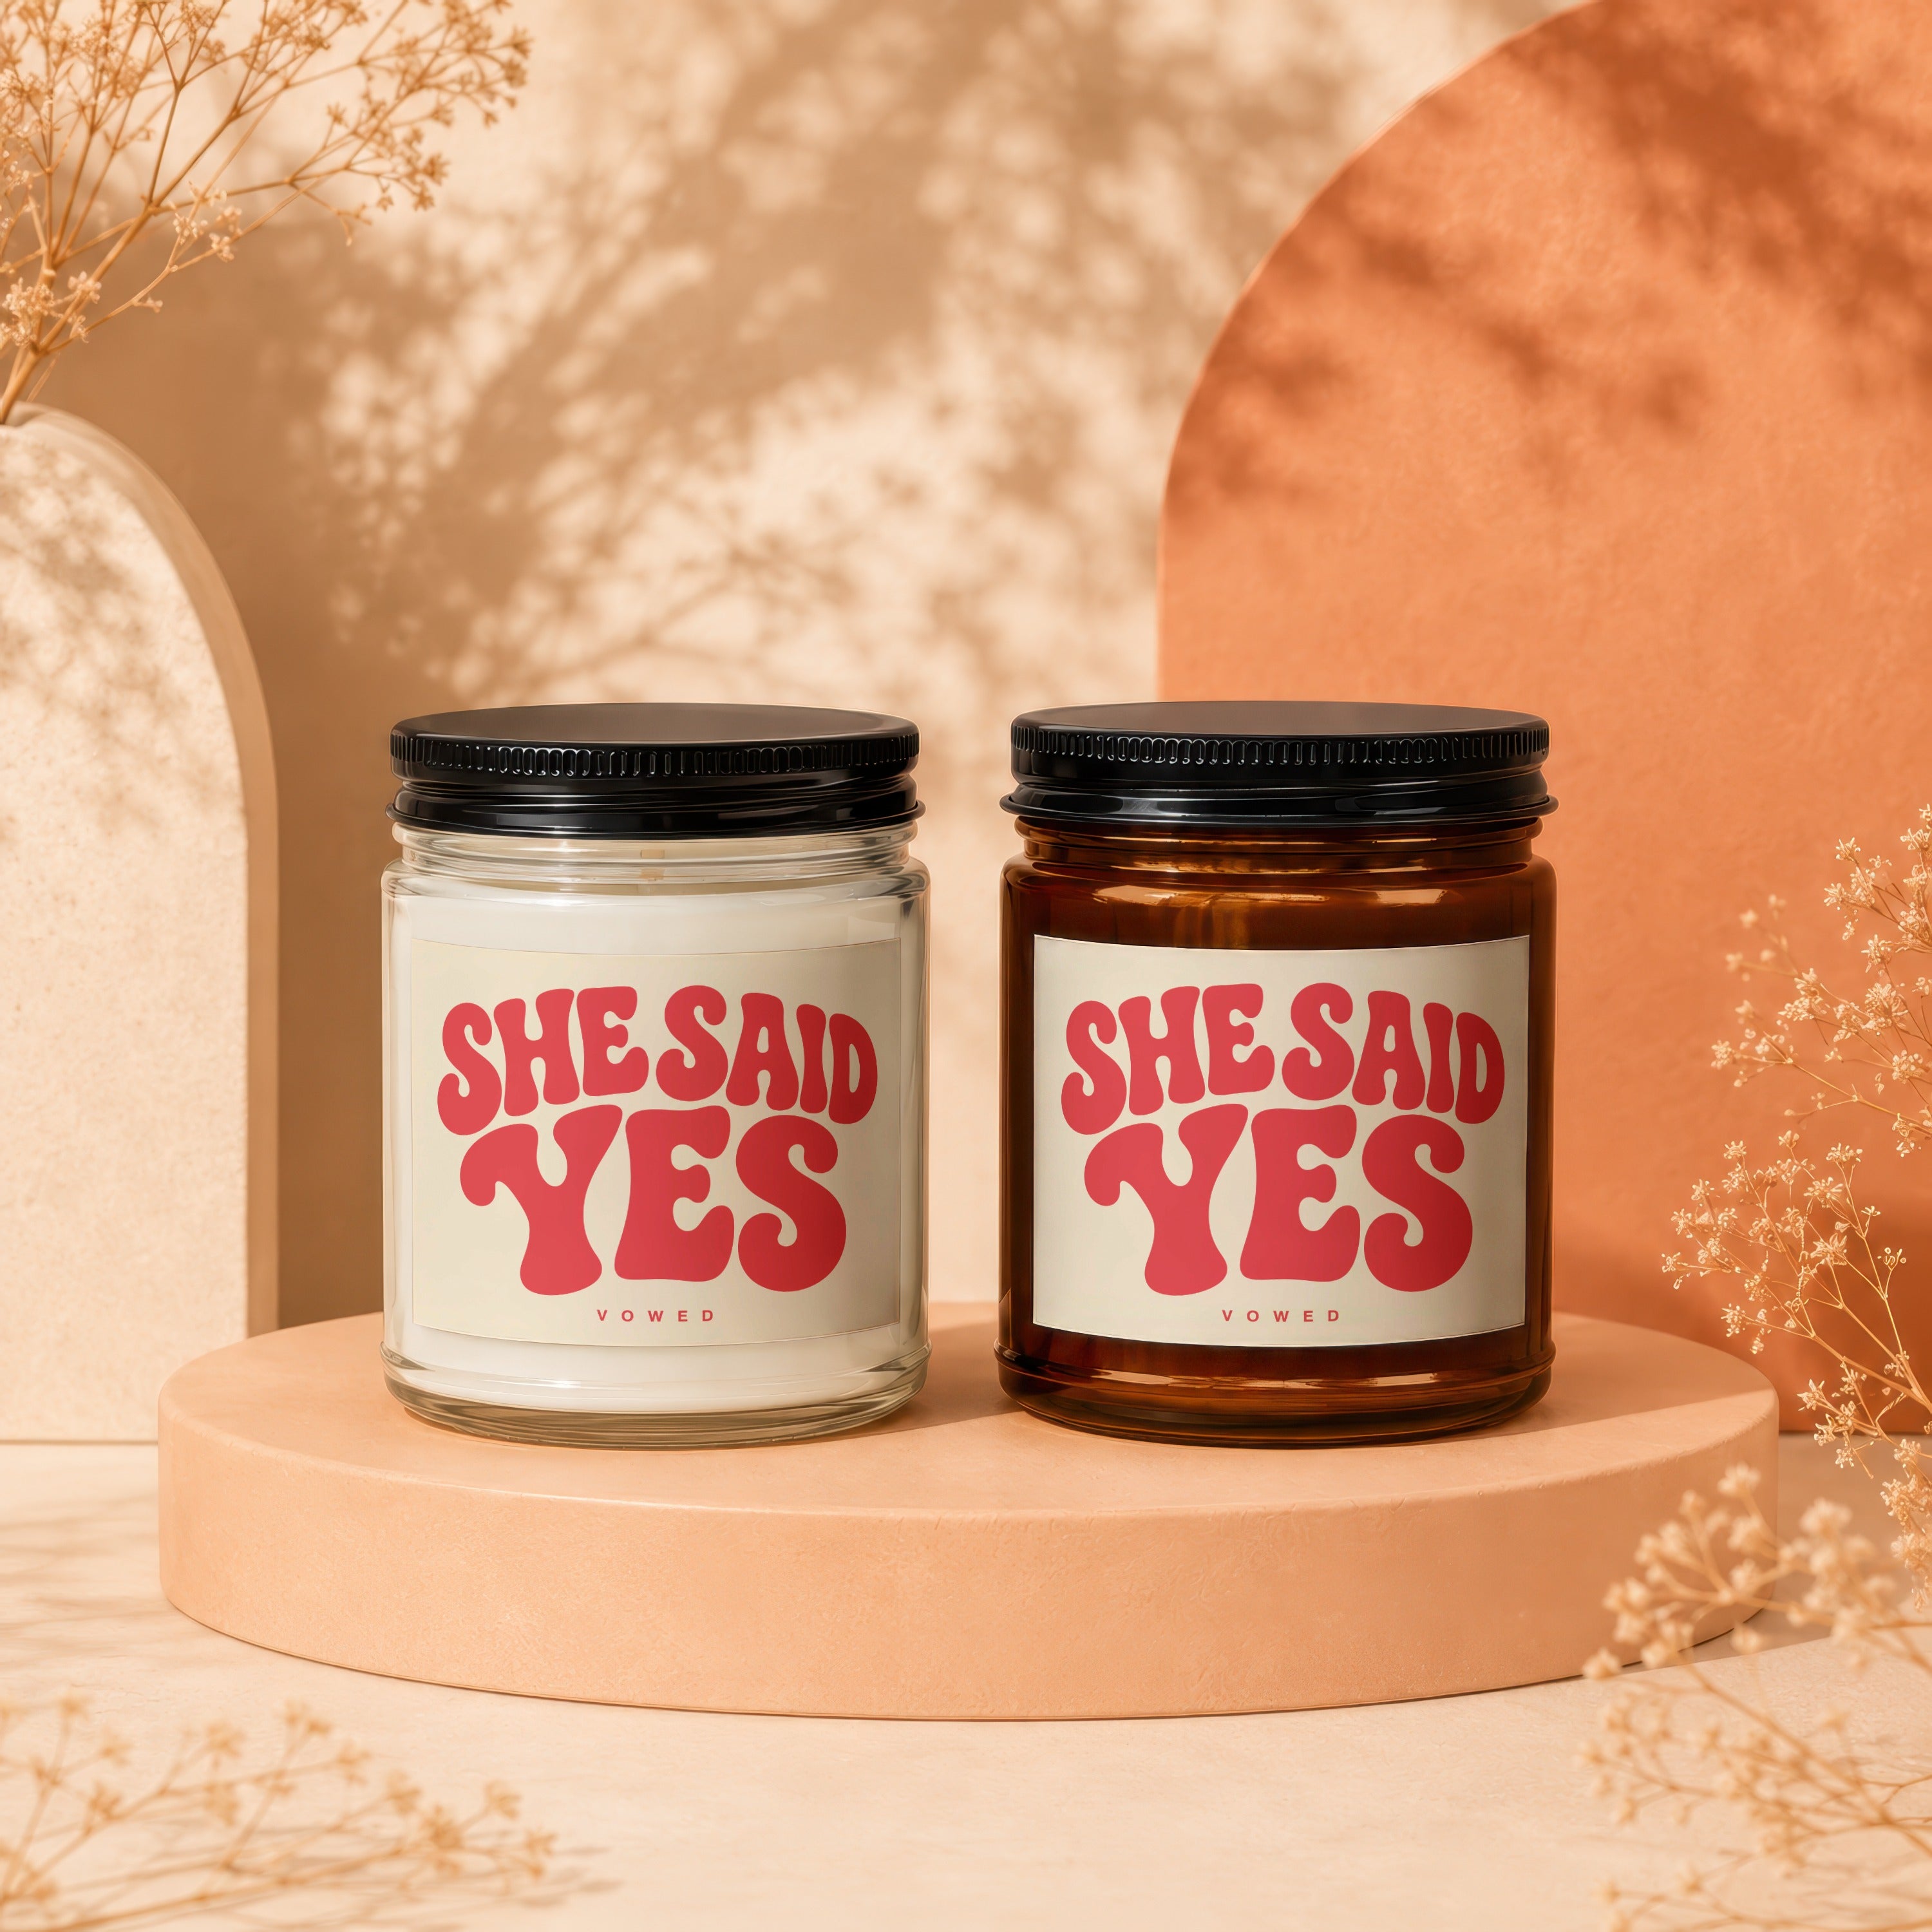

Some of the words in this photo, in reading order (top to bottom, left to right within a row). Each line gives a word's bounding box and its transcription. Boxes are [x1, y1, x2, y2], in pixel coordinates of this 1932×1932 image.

[437, 985, 650, 1136] SHE
[655, 985, 878, 1125] SAID
[1061, 983, 1276, 1135] SHE
[1281, 982, 1505, 1124] SAID
[459, 1104, 847, 1296] YES
[1084, 1103, 1473, 1296] YES
[596, 1309, 714, 1322] VOWED
[1222, 1309, 1340, 1322] VOWED
